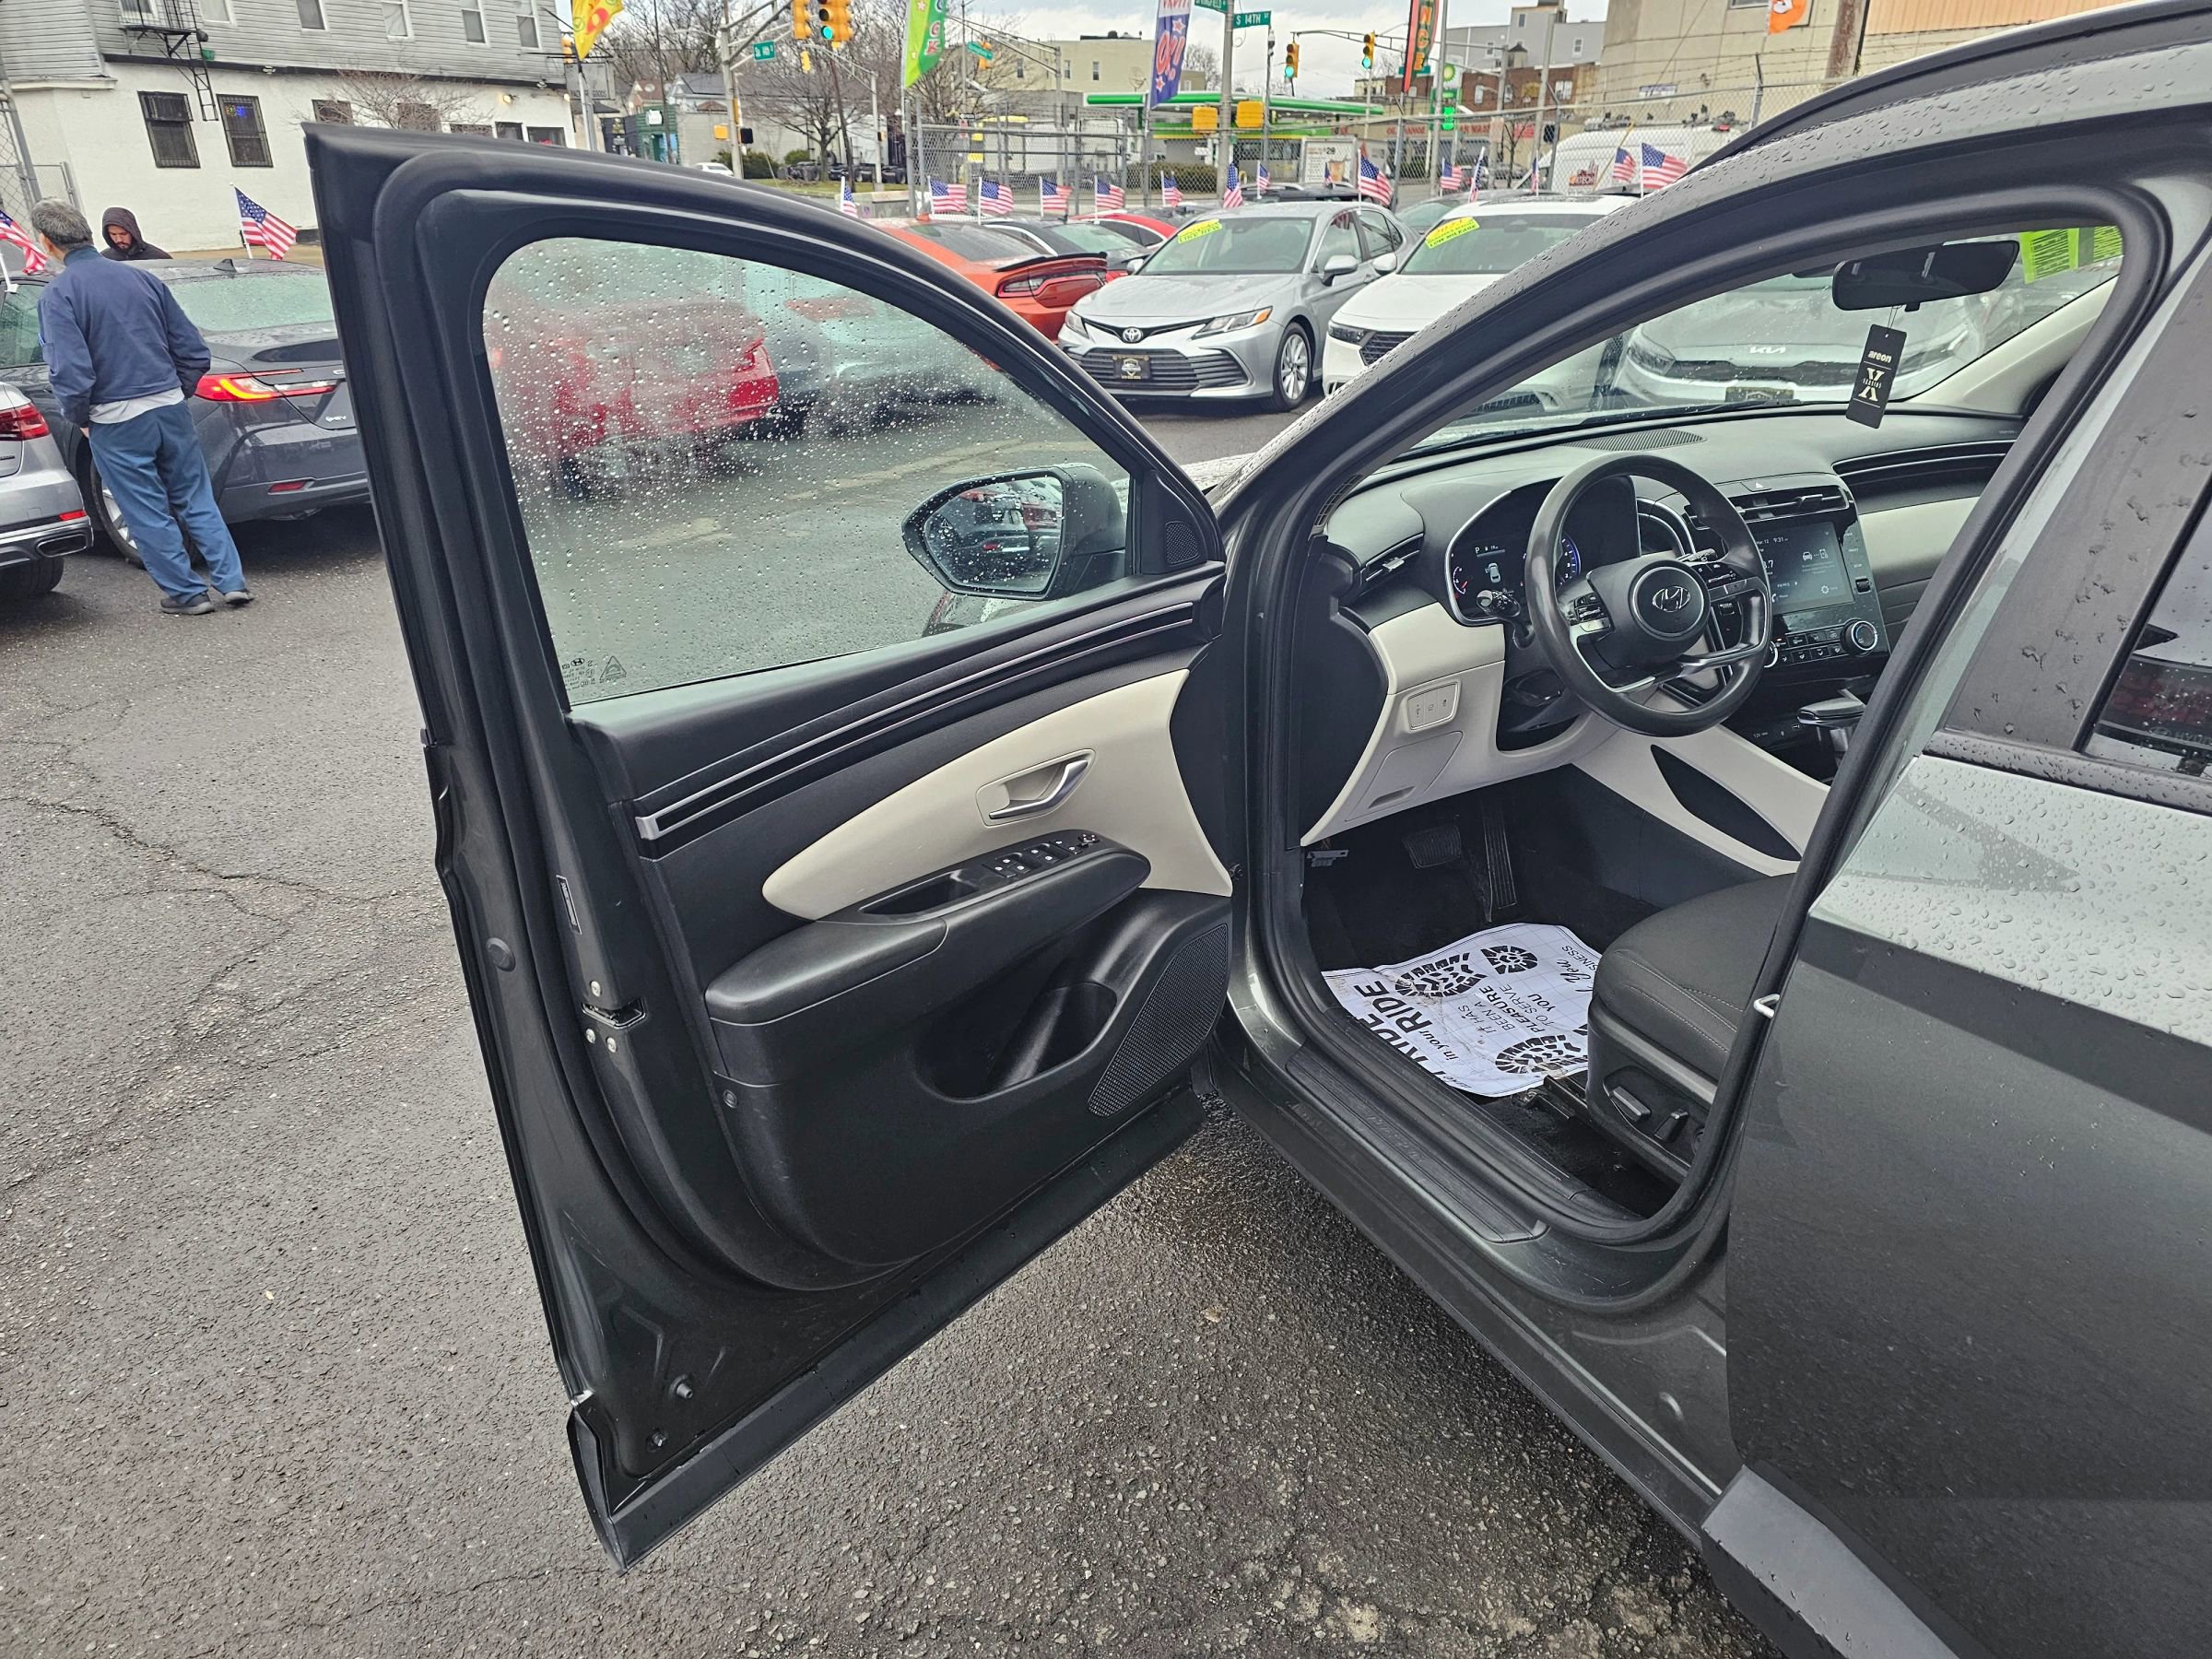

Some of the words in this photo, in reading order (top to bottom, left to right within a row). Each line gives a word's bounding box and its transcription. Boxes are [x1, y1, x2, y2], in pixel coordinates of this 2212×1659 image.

[1236, 16, 1241, 25] S
[1244, 14, 1261, 24] 14TH
[1868, 350, 1892, 363] areon
[1354, 981, 1433, 1033] RIDE
[1499, 983, 1536, 1014] SERVE
[1527, 994, 1556, 1012] YOU
[1458, 1005, 1485, 1024] HAS
[1479, 985, 1545, 1033] PLEASURE
[1482, 1009, 1515, 1031] BEEN
[1535, 1015, 1555, 1027] TO
[1418, 1030, 1450, 1051] your
[1443, 1052, 1460, 1061] in
